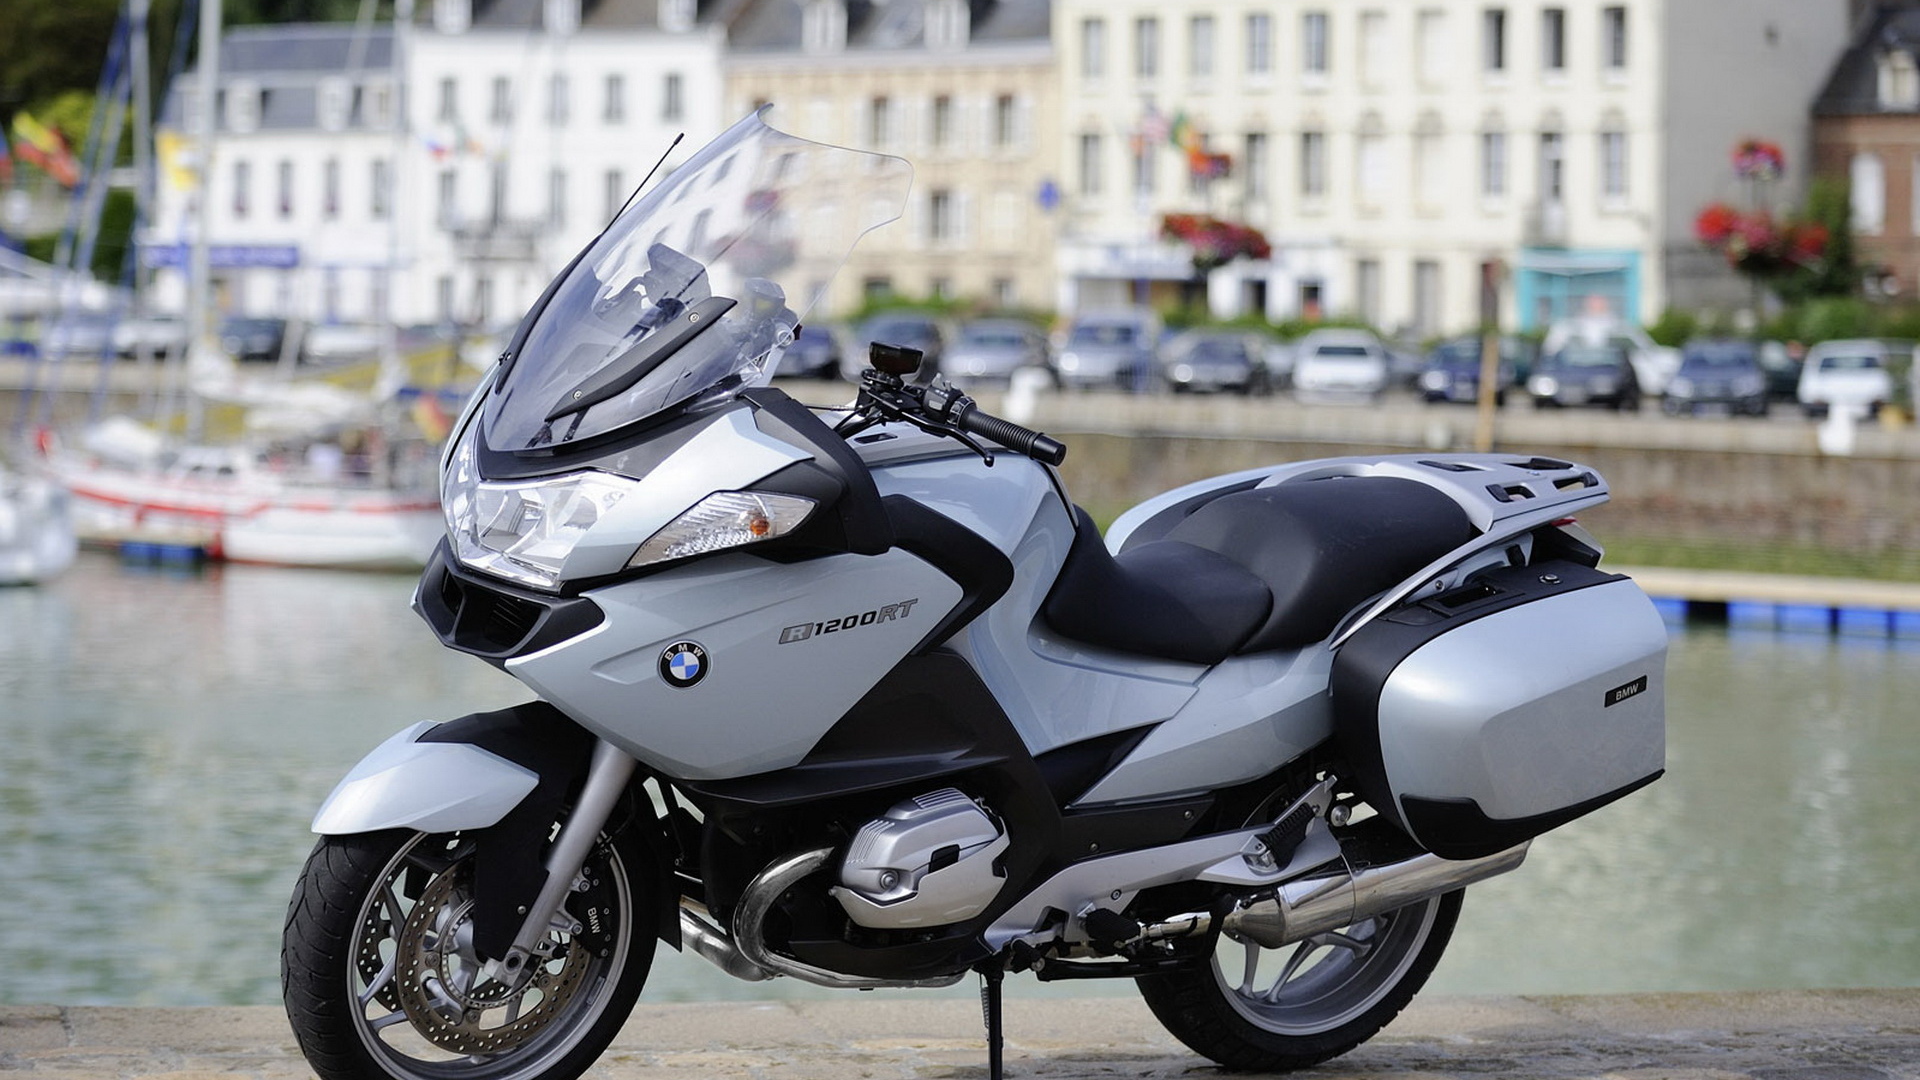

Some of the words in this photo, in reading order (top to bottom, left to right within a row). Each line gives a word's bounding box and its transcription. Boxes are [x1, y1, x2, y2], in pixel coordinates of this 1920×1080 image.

[665, 643, 703, 660] BMW
[1616, 683, 1639, 701] BMW
[587, 907, 600, 933] BMW
